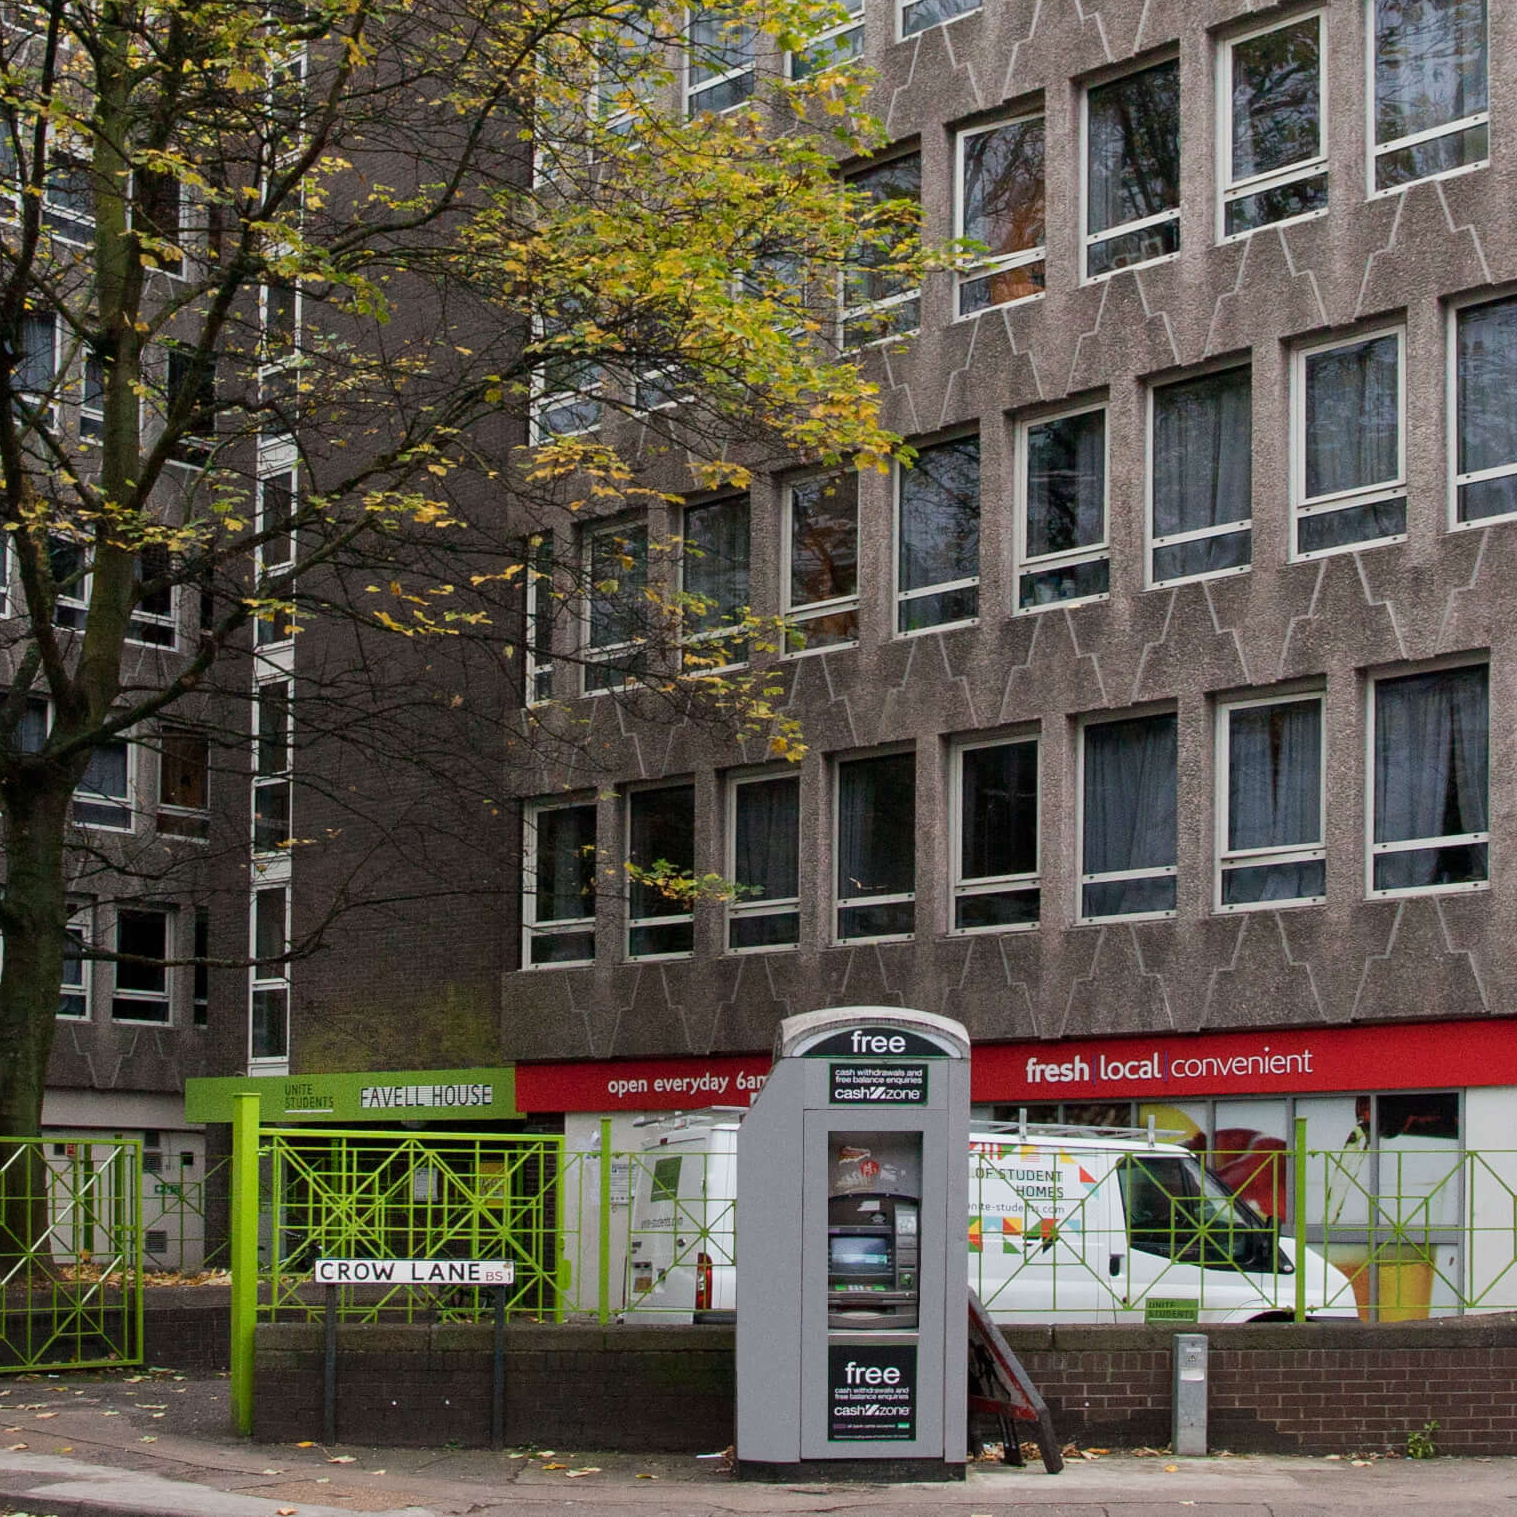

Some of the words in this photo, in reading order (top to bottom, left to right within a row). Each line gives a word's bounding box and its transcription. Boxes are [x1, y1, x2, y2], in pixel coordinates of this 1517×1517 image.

[851, 1030, 907, 1053] free
[835, 1068, 855, 1076] cash
[857, 1068, 905, 1076] withdrawals
[907, 1068, 923, 1076] and
[1025, 1055, 1090, 1083] fresh
[1100, 1052, 1161, 1081] local
[1170, 1046, 1313, 1078] convenient
[608, 1079, 648, 1098] open
[653, 1072, 729, 1095] everyday
[886, 1076, 923, 1084] enquiries
[284, 1083, 313, 1096] UNITE
[360, 1086, 425, 1108] FAVELL
[432, 1084, 492, 1106] HOUSE
[284, 1096, 333, 1108] STUDENTS
[999, 1169, 1064, 1182] STUDENT
[1016, 1184, 1064, 1198] HOMES
[320, 1262, 396, 1281] CROW
[411, 1263, 481, 1281] LANE
[485, 1271, 504, 1282] BS
[845, 1361, 901, 1384] free
